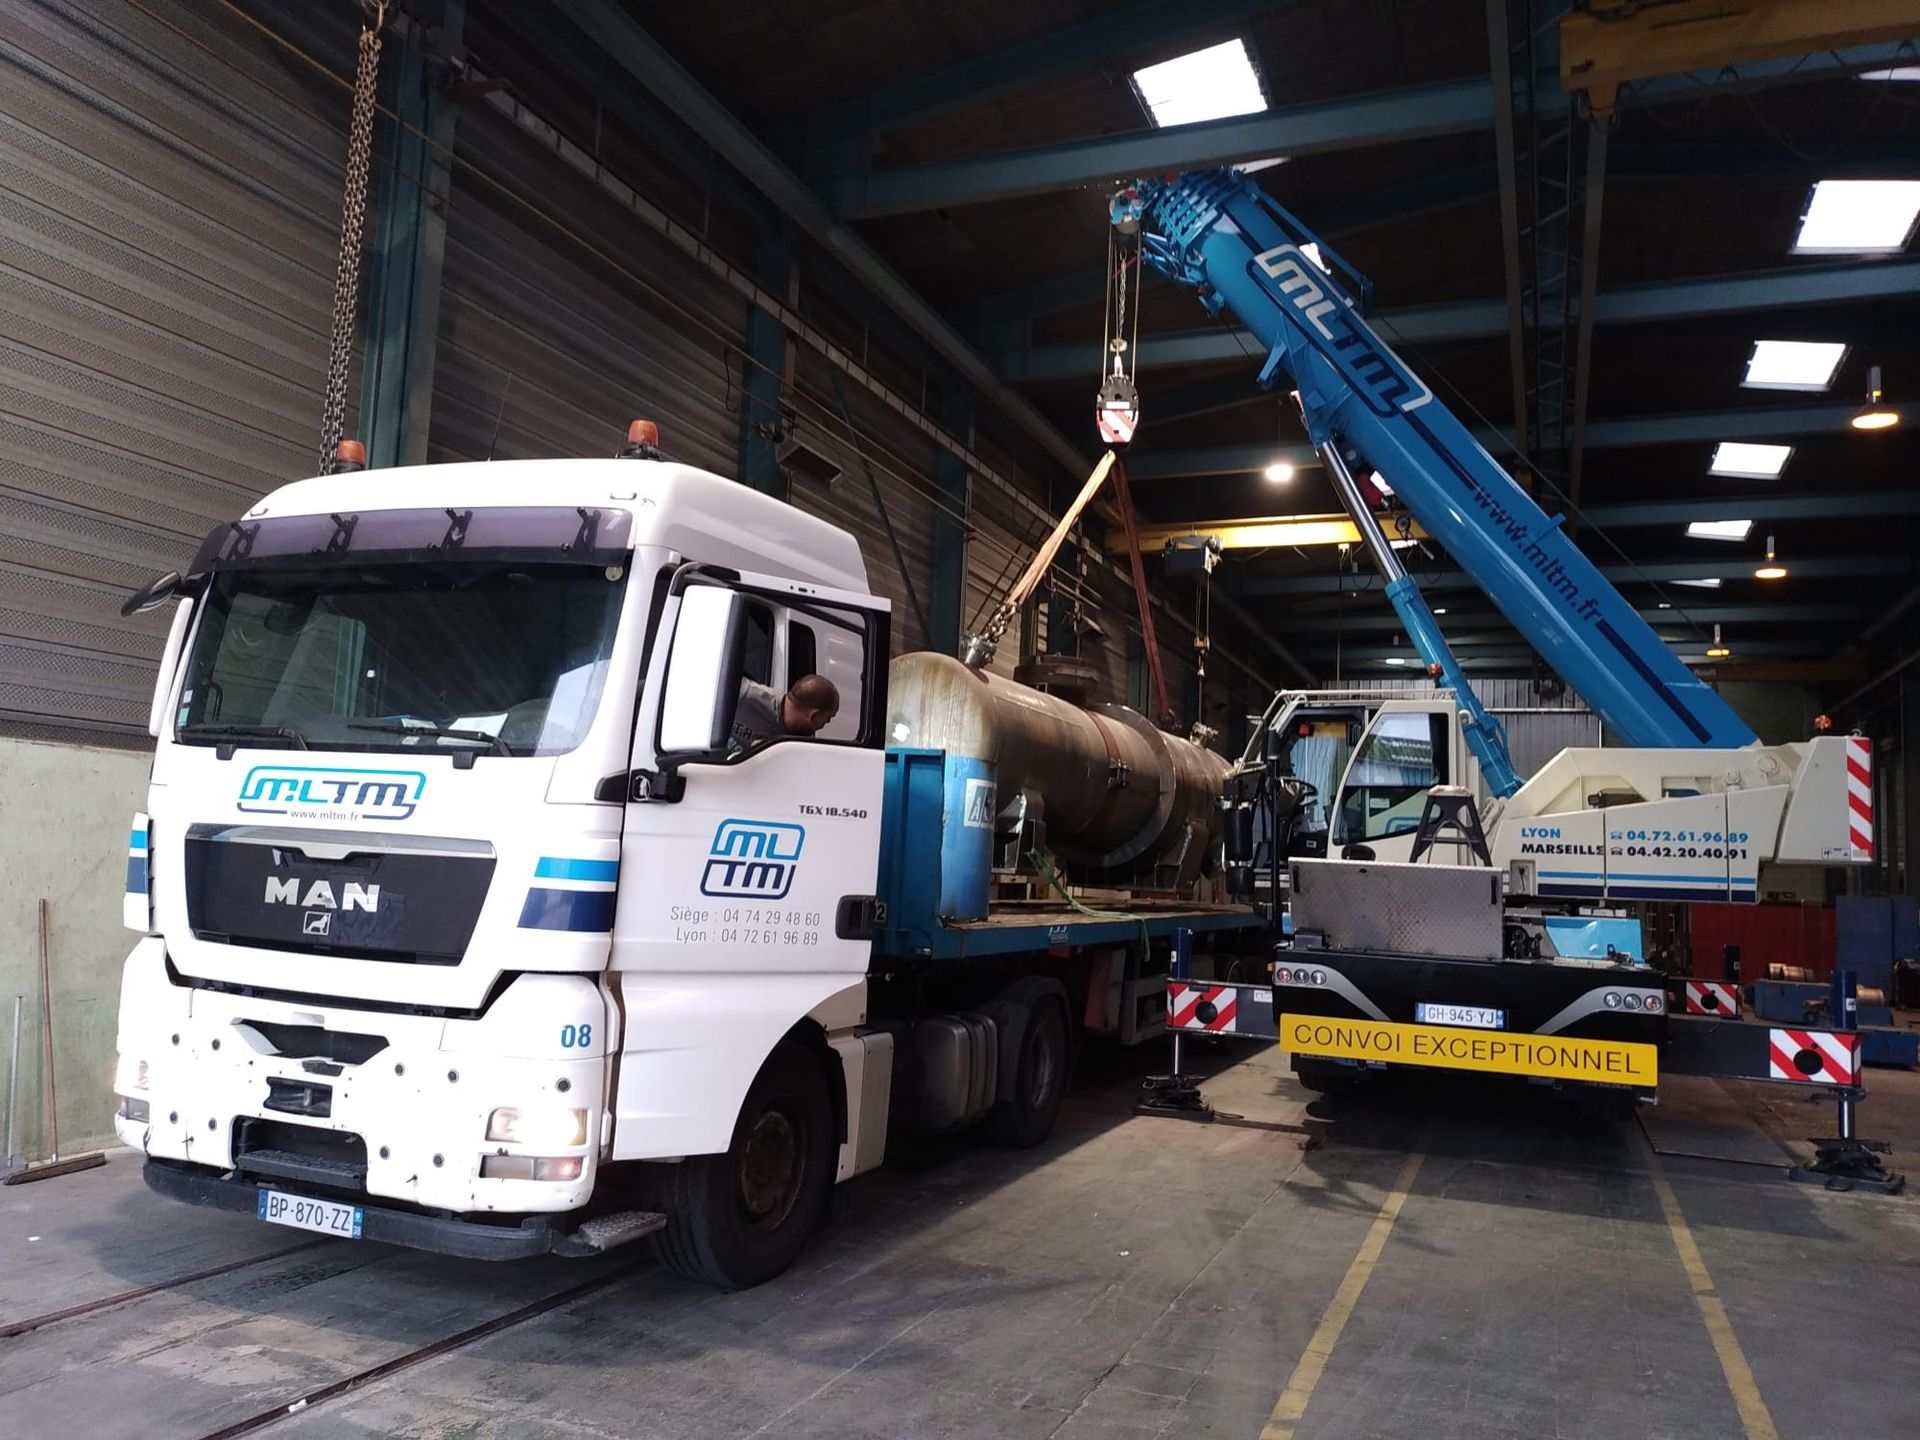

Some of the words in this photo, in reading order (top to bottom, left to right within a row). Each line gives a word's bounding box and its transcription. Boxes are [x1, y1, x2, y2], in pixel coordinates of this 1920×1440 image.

[1253, 244, 1414, 405] MLTM
[1474, 487, 1601, 622] www.mltm.fr
[290, 810, 360, 822] www.mltm.fr
[798, 804, 823, 816] TGX
[825, 806, 868, 819] 18.540
[1521, 827, 1561, 839] LYON
[1626, 830, 1749, 843] 04.72.61.96.89
[1626, 846, 1748, 860] 04.42.20.40.91
[264, 876, 381, 913] MAN
[670, 905, 709, 925] Siège
[723, 908, 740, 923] 04
[745, 909, 760, 924] 74
[765, 910, 781, 925] 29
[785, 911, 801, 926] 48
[805, 912, 820, 927] 60
[676, 926, 707, 944] Lyon
[721, 928, 737, 943] 04
[743, 929, 759, 944] 72
[763, 930, 777, 945] 61
[783, 930, 799, 945] 96
[802, 931, 818, 946] 89
[1428, 1006, 1494, 1025] GH-945-YJ
[561, 1023, 592, 1048] 08
[1294, 1023, 1401, 1054] CONVOI
[1413, 1034, 1642, 1076] EXCEPTIONNEL
[269, 1196, 351, 1232] BP-870-ZZ
